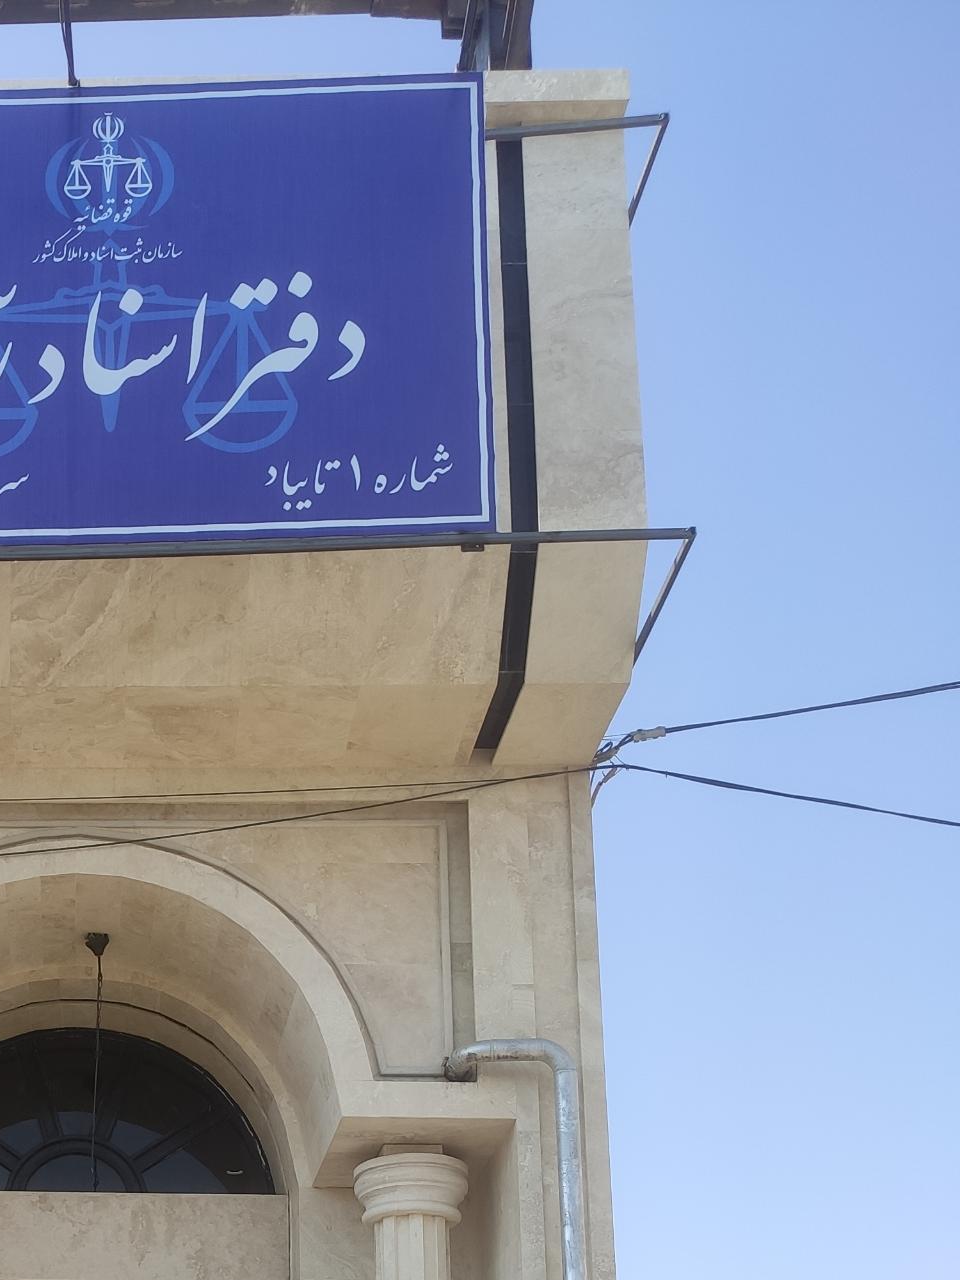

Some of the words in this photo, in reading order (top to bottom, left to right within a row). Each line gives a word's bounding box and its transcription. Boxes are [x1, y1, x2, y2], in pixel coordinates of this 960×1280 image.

[113, 198, 133, 223] قوه
[32, 228, 72, 263] کشور
[53, 228, 84, 263] املاک
[82, 251, 89, 262] و
[89, 246, 114, 262] اسناد
[114, 237, 143, 264] ثبت
[141, 241, 183, 263] سازمان
[28, 288, 208, 406] اسناد
[184, 271, 366, 441] دفتر
[264, 459, 341, 511] تایباد
[350, 453, 361, 491] ۱
[374, 444, 453, 494] شماره
